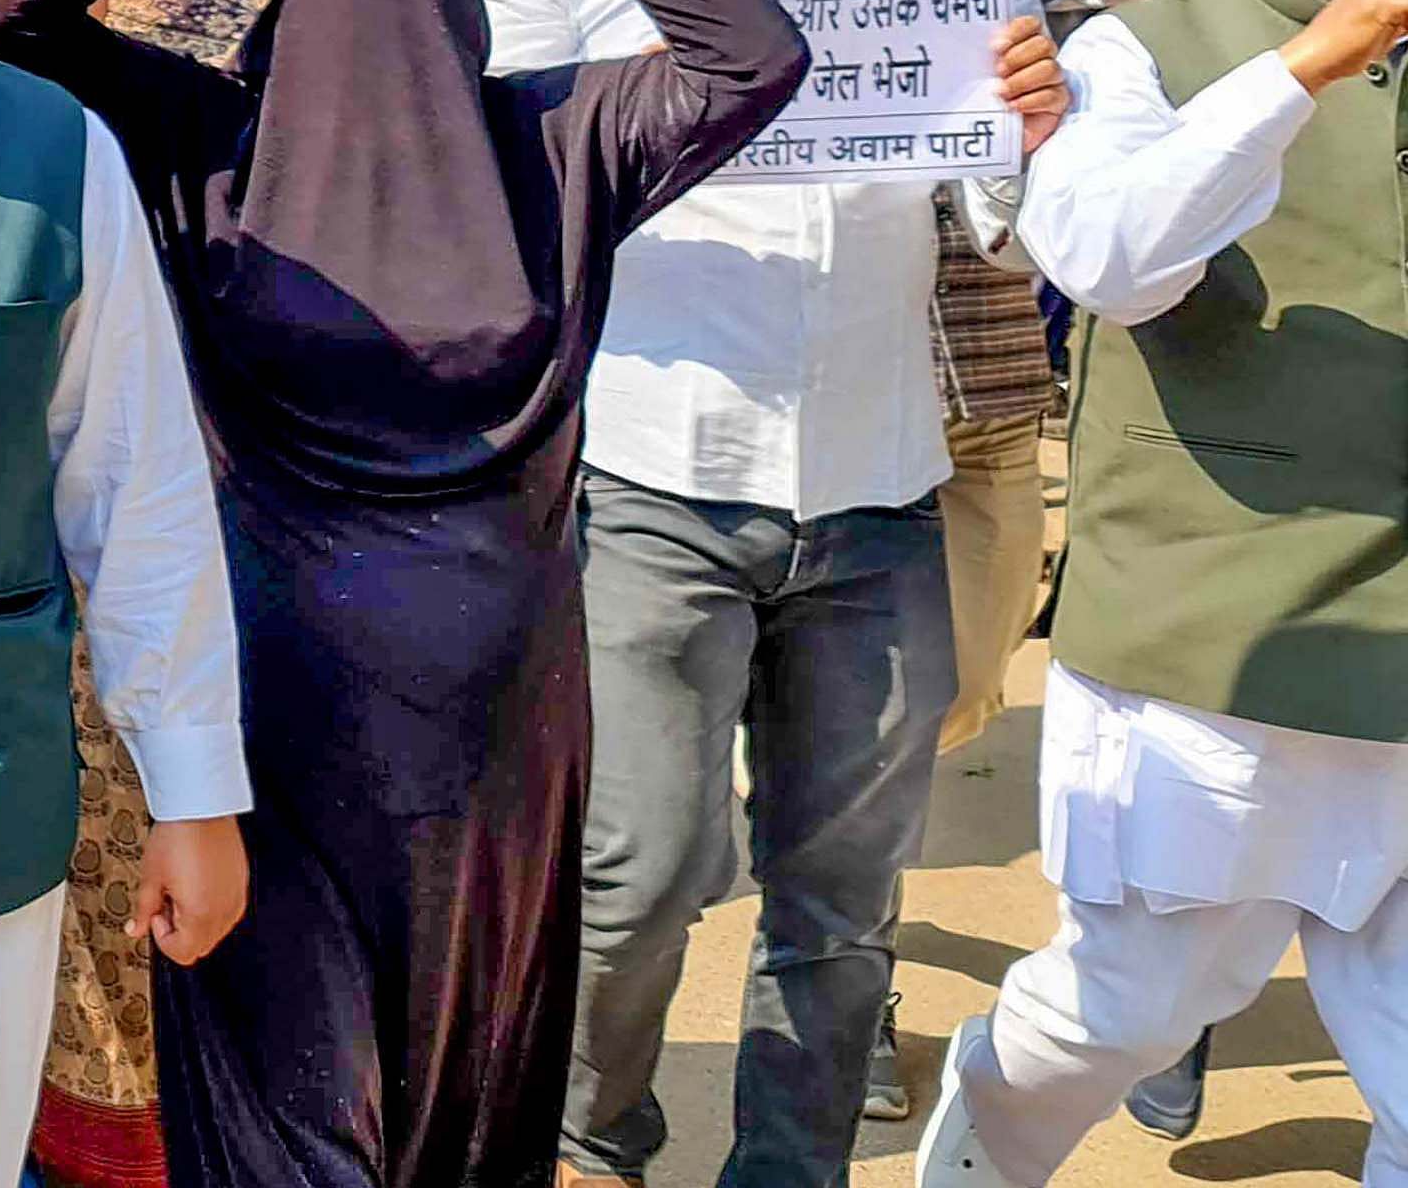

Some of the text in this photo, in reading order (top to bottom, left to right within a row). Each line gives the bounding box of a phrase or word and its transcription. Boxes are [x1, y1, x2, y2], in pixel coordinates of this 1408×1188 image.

[814, 45, 932, 101] जेल भेजो
[827, 133, 917, 164] अवाम
[928, 120, 994, 159] पार्टी
